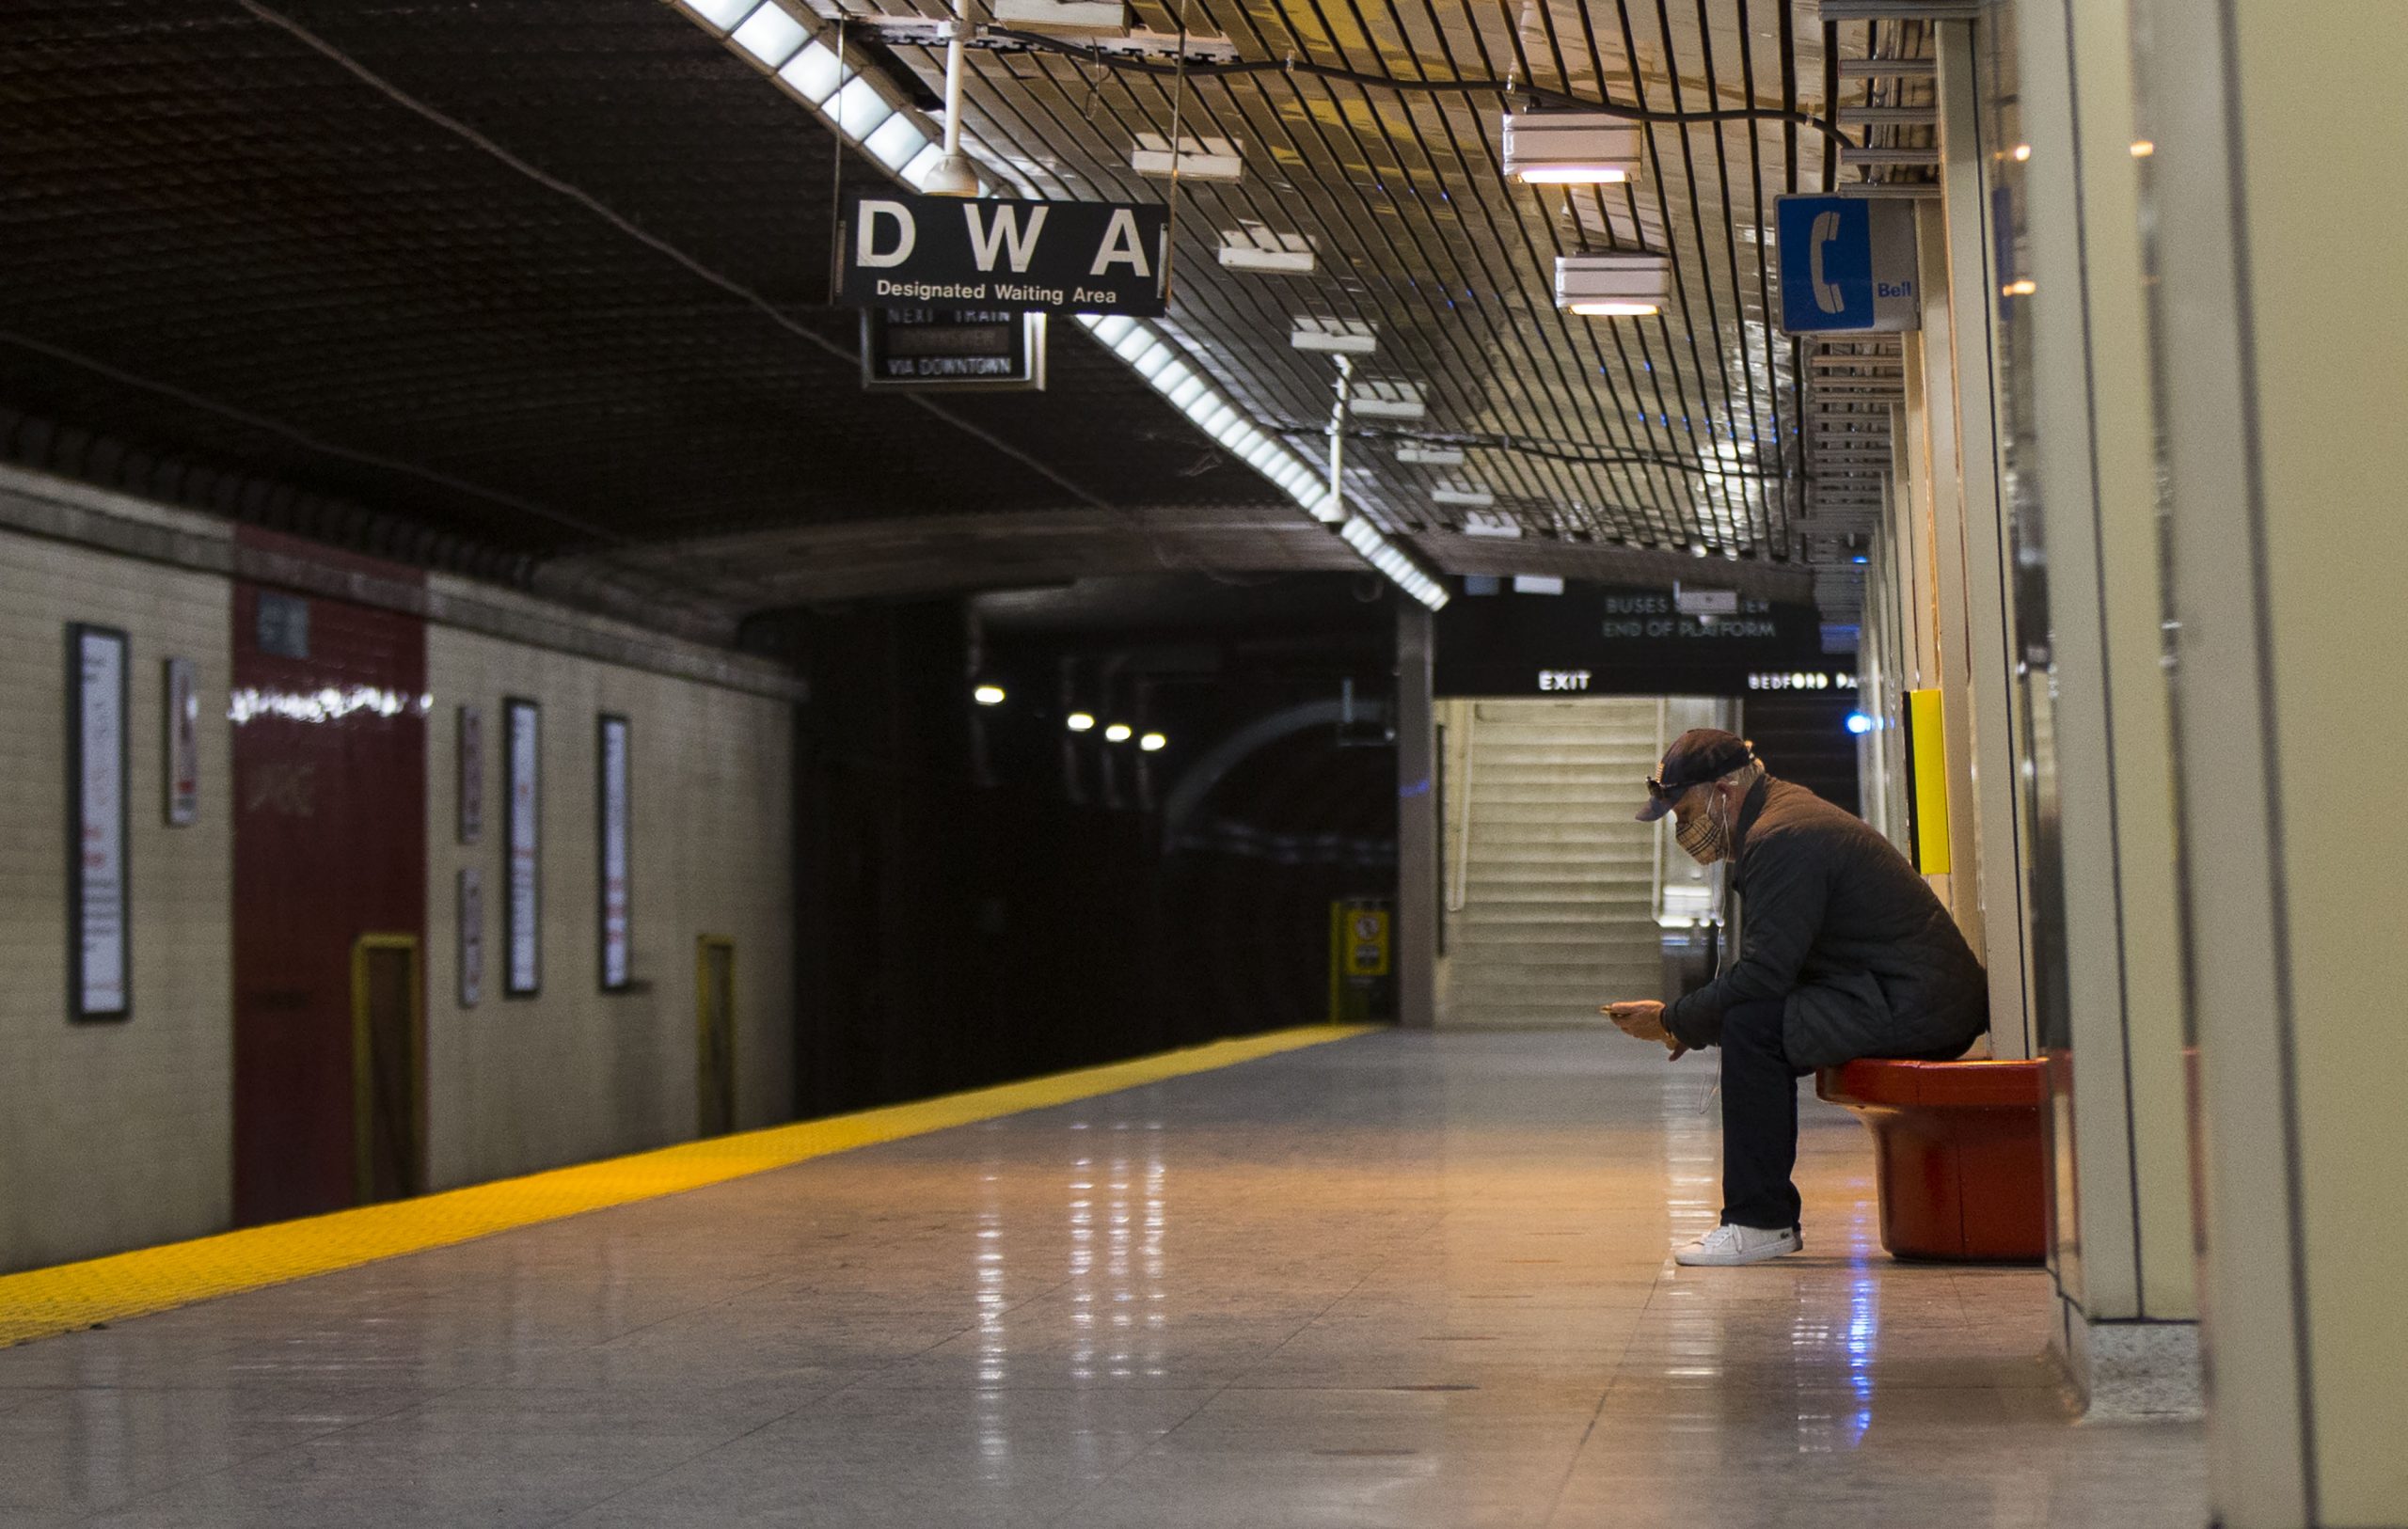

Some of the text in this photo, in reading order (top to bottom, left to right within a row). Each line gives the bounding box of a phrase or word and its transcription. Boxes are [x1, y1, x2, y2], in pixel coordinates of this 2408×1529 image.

[857, 199, 1151, 277] D W A
[876, 279, 1117, 305] Designated Waiting Area
[1877, 281, 1911, 297] Bell
[887, 357, 1012, 375] VIA DOWNTOWN
[1605, 597, 1669, 614] BUSES
[1602, 621, 1777, 638] END OF PLATFORM
[1538, 670, 1592, 690] EXIT
[1748, 671, 1829, 689] BEDFORD
